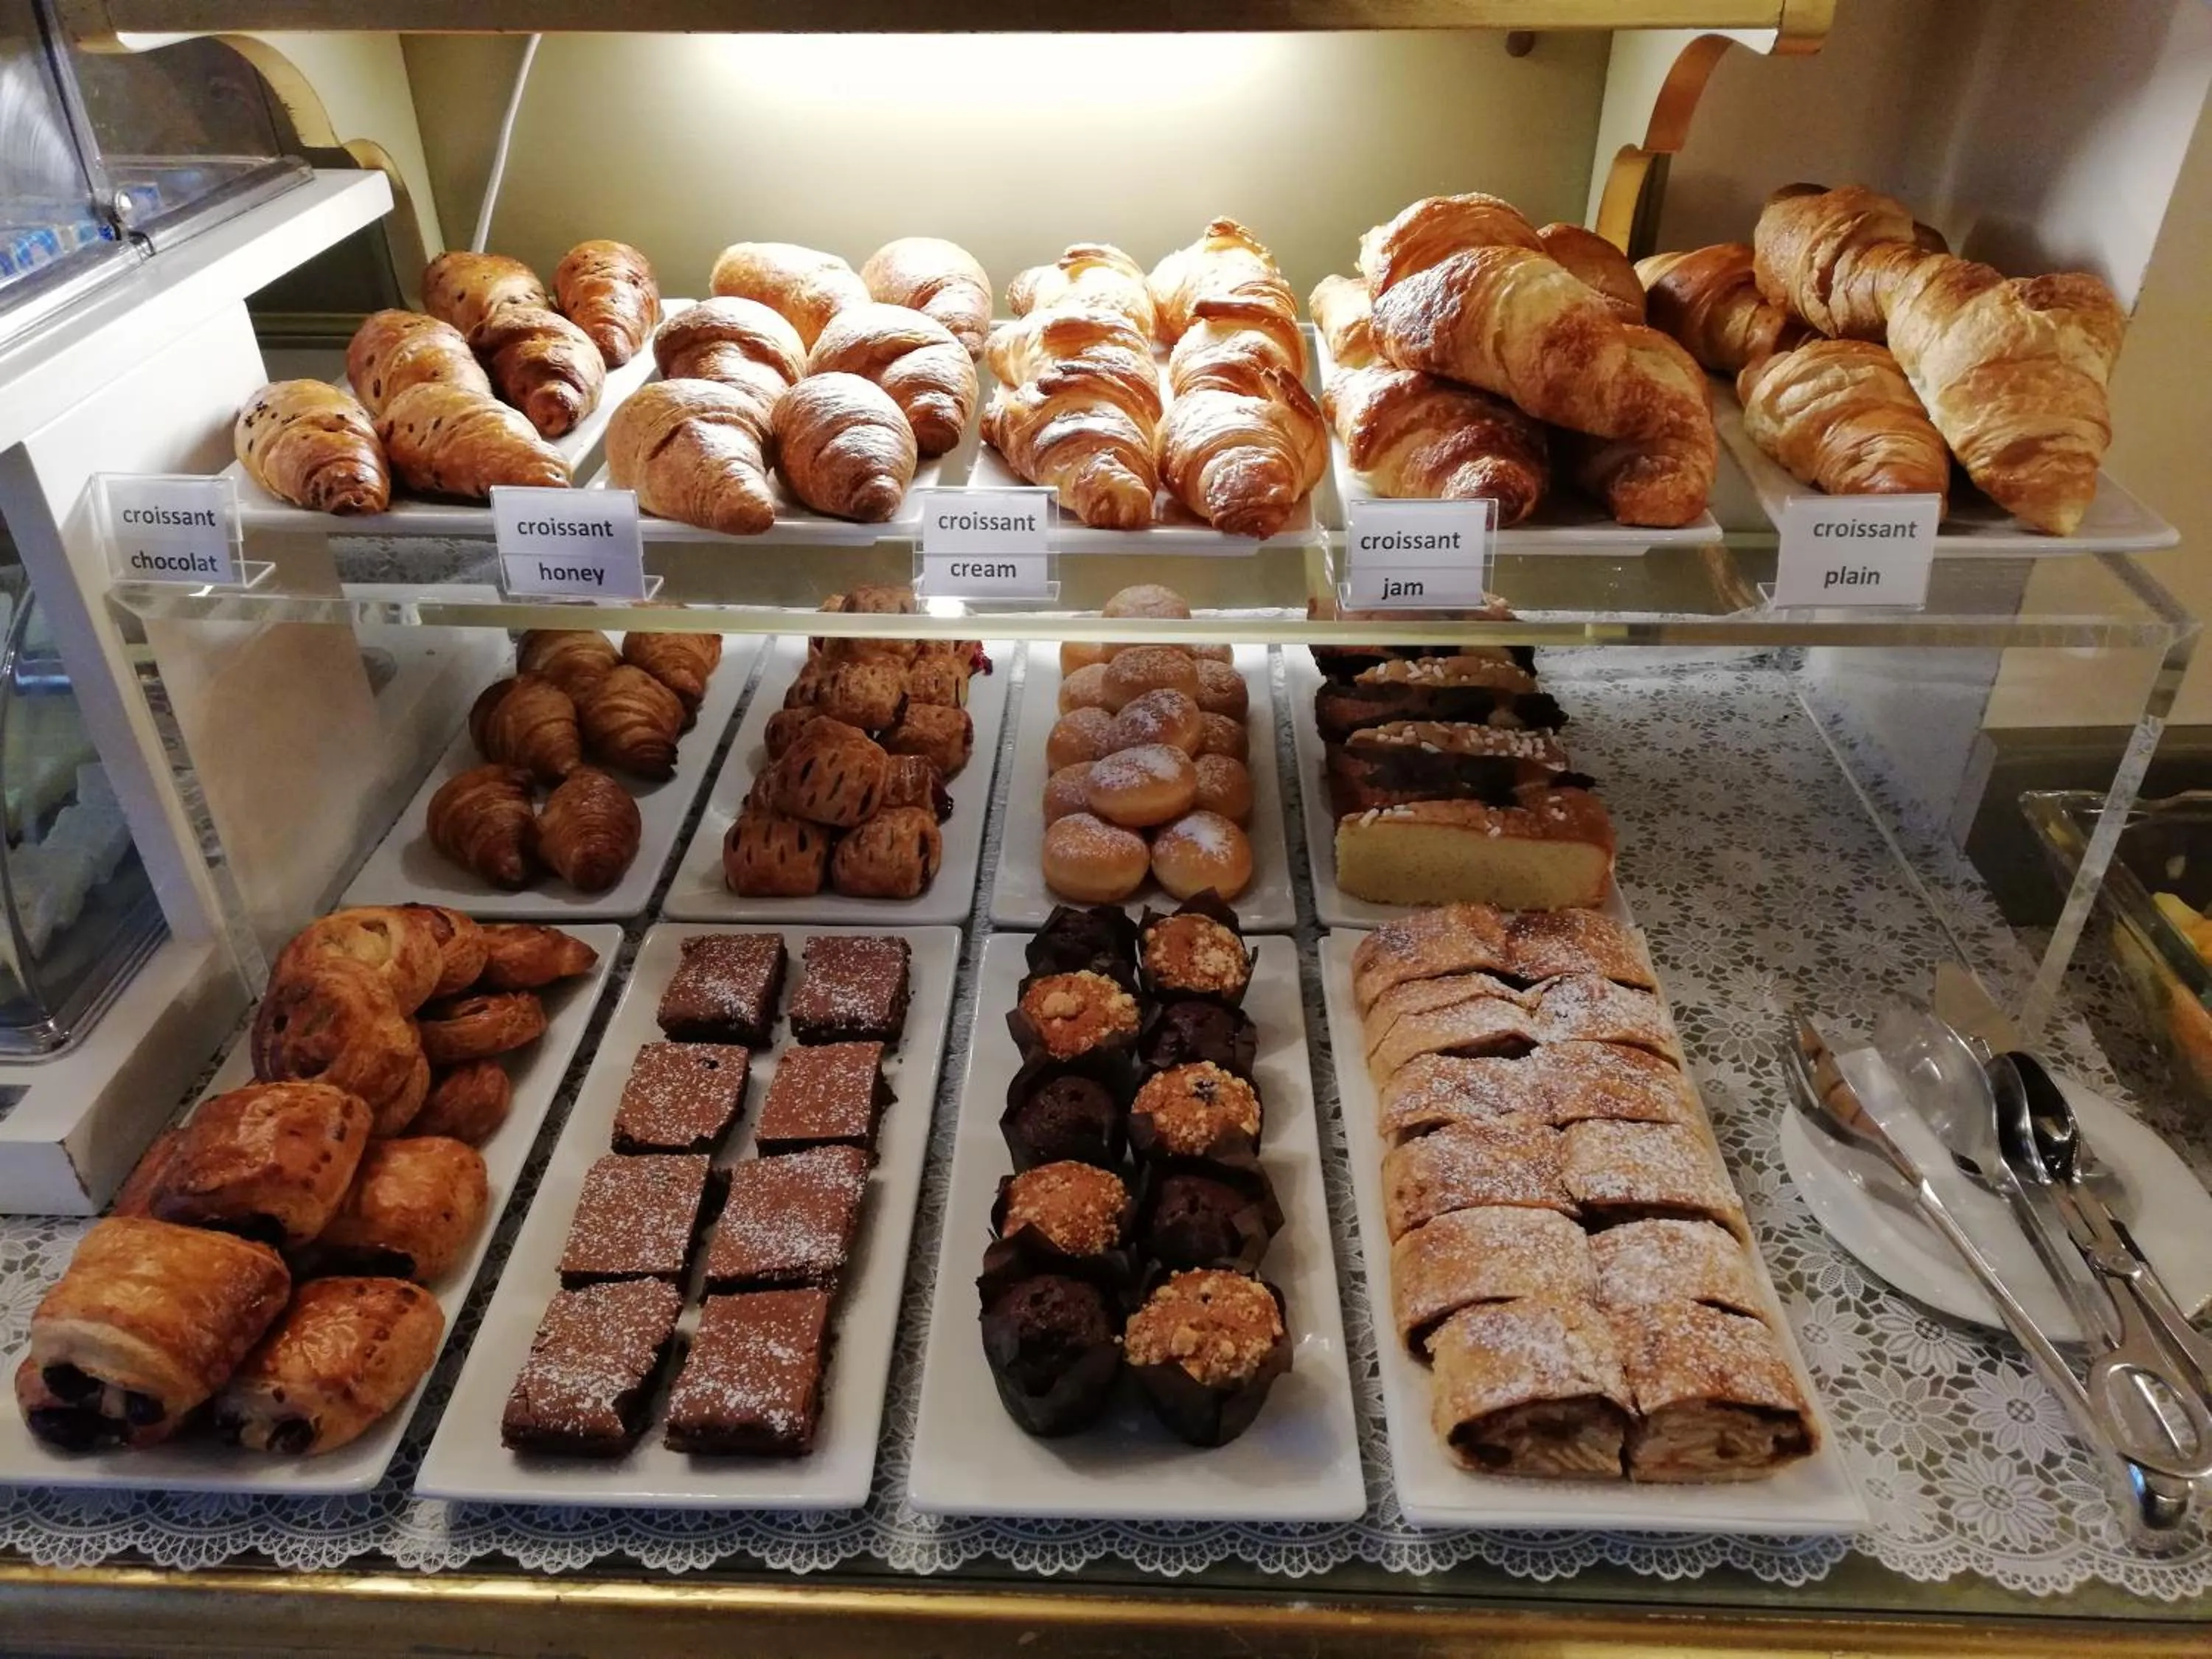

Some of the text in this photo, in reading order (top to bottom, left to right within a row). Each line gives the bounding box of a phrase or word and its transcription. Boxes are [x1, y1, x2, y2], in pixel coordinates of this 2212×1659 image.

[123, 506, 216, 526] croissant
[939, 512, 1036, 532] croissant
[518, 518, 614, 538] croissant
[1813, 519, 1919, 538] croissant
[1360, 531, 1461, 550] croissant
[131, 550, 218, 572] chocolat
[950, 563, 1017, 578] cream
[539, 562, 605, 585] honey
[1823, 566, 1881, 589] plain
[1381, 578, 1424, 599] jam
